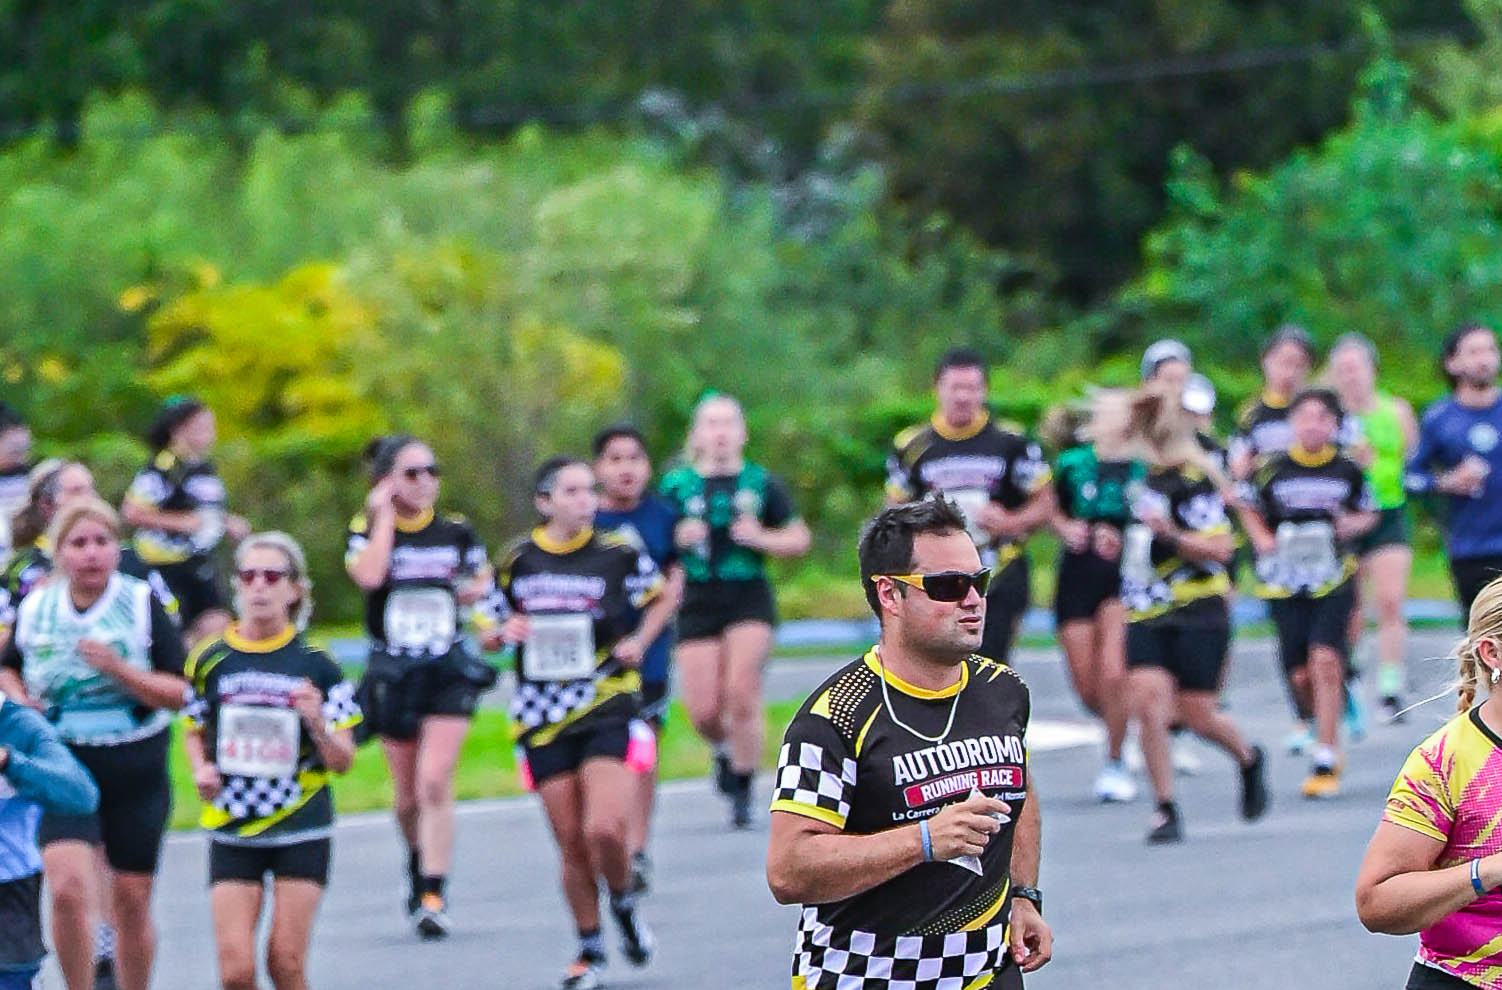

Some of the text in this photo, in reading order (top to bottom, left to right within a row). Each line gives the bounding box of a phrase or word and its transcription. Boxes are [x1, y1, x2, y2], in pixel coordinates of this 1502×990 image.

[892, 735, 1024, 786] AUTÓDROMO
[920, 769, 1014, 802] RUNNING RACE
[892, 811, 905, 821] La
